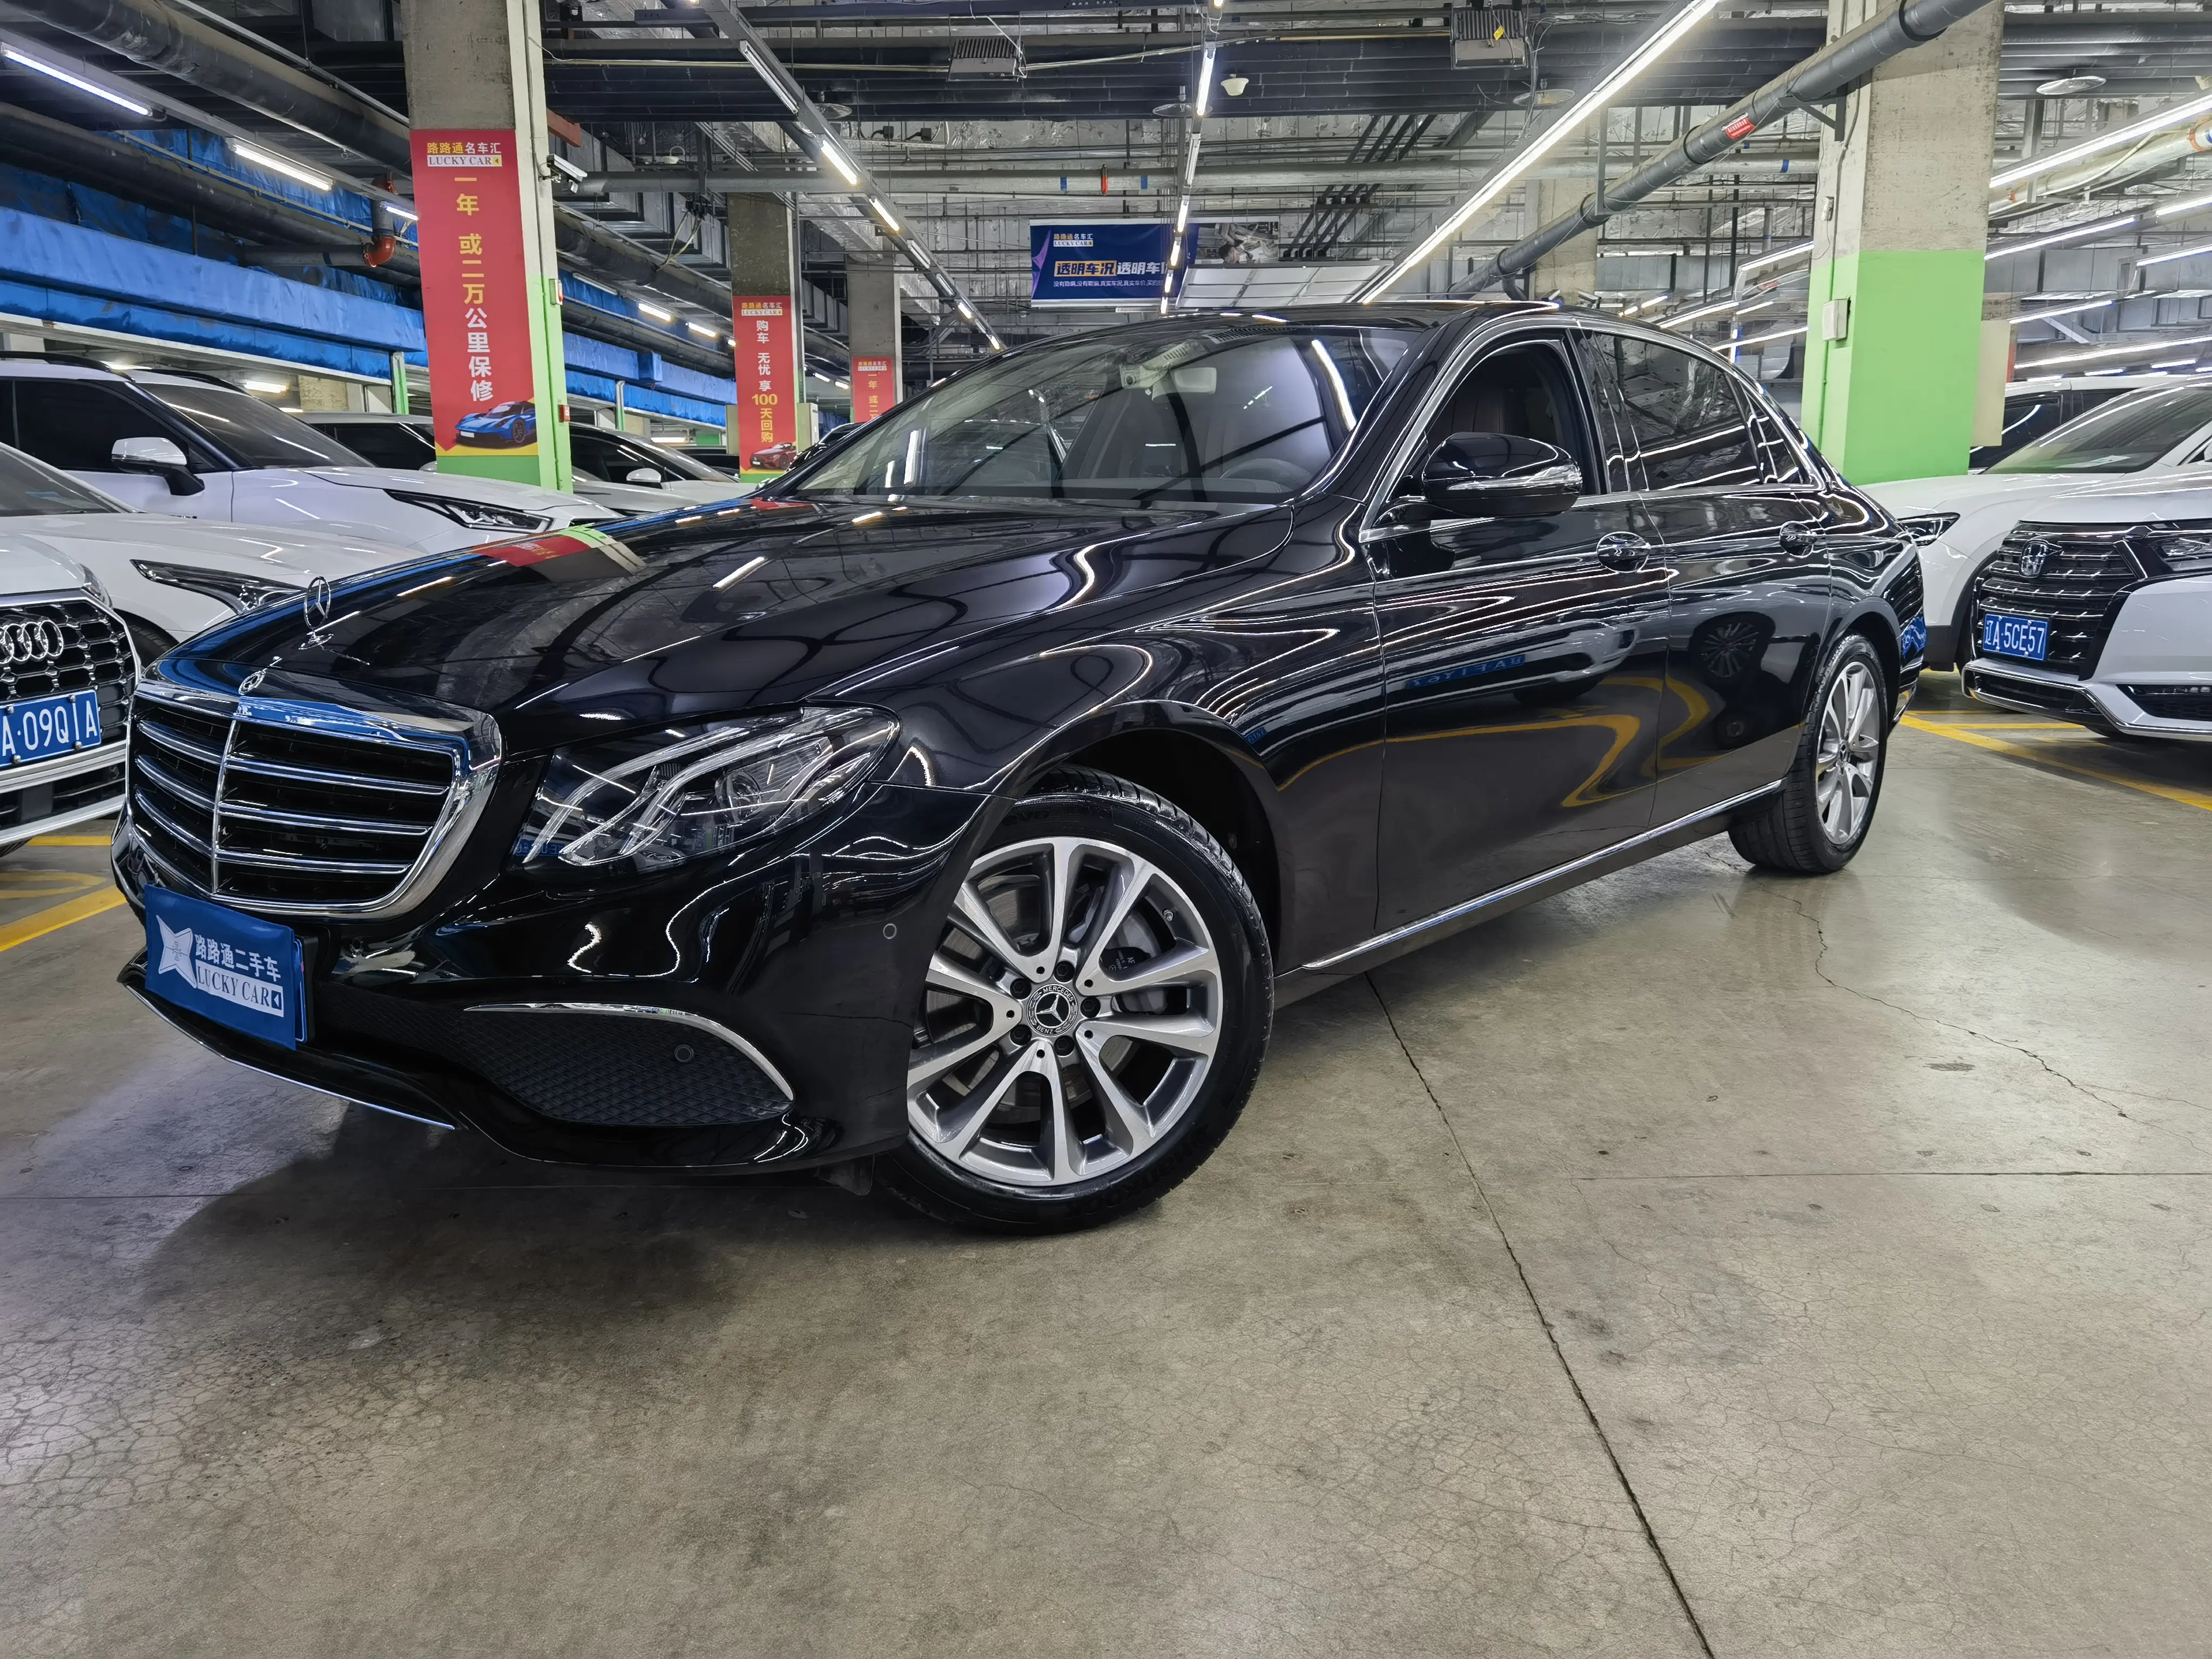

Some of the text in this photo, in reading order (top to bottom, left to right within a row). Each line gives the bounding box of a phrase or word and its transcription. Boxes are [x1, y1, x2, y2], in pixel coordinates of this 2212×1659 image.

[427, 142, 501, 154] 路路通名车汇
[429, 157, 492, 165] LUCKY CAR
[1984, 620, 2045, 653] 辽A·5CE57
[194, 934, 281, 981] 路路通二手车
[197, 966, 269, 1007] LUCKY CAR
[1043, 986, 1074, 1002] MERCEDES
[1036, 1025, 1054, 1034] BENZ
